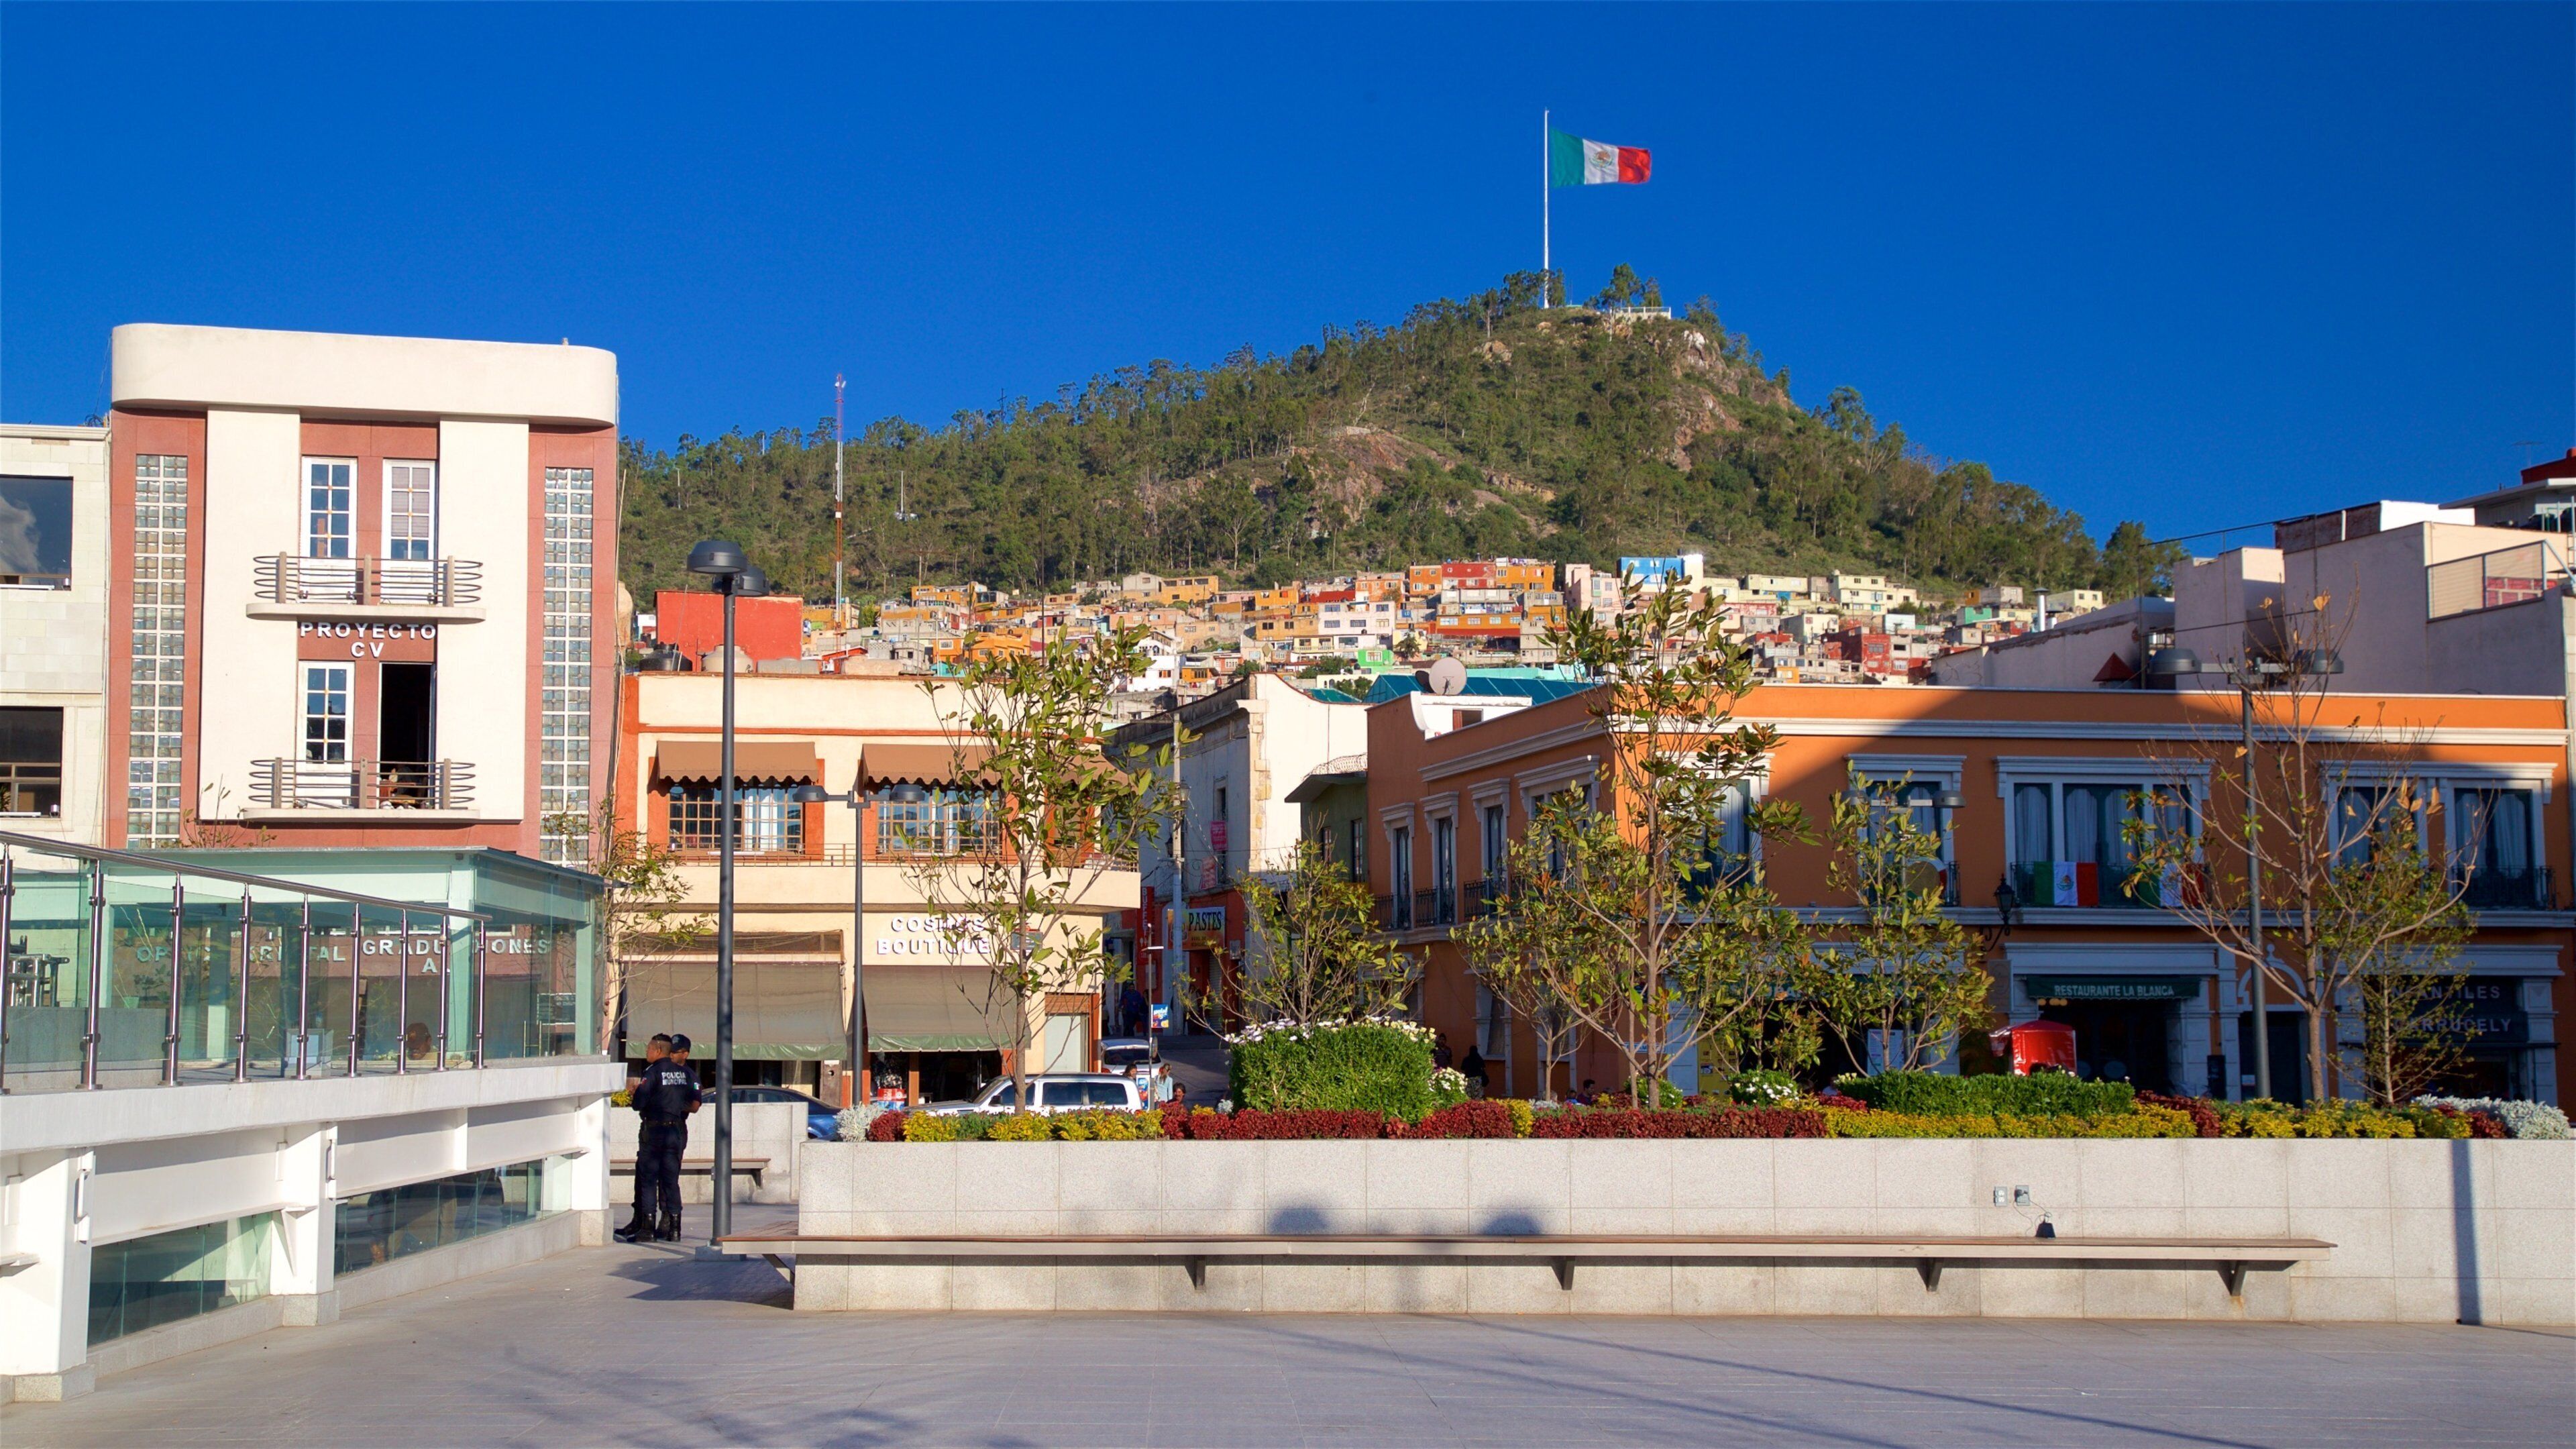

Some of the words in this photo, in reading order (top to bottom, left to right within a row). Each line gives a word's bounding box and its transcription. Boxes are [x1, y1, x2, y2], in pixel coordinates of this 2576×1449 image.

[300, 622, 436, 639] PROYECTO
[350, 641, 384, 658] CV
[1188, 912, 1222, 931] PASTES
[249, 945, 346, 962] RIAL
[362, 939, 550, 955] GRADUIONES
[877, 938, 991, 955] BOUTIQUE
[2054, 985, 2121, 996] RESTAURANTE
[2123, 985, 2135, 996] LA
[2137, 985, 2175, 996] BLANCA
[2390, 985, 2501, 1000] NANILES
